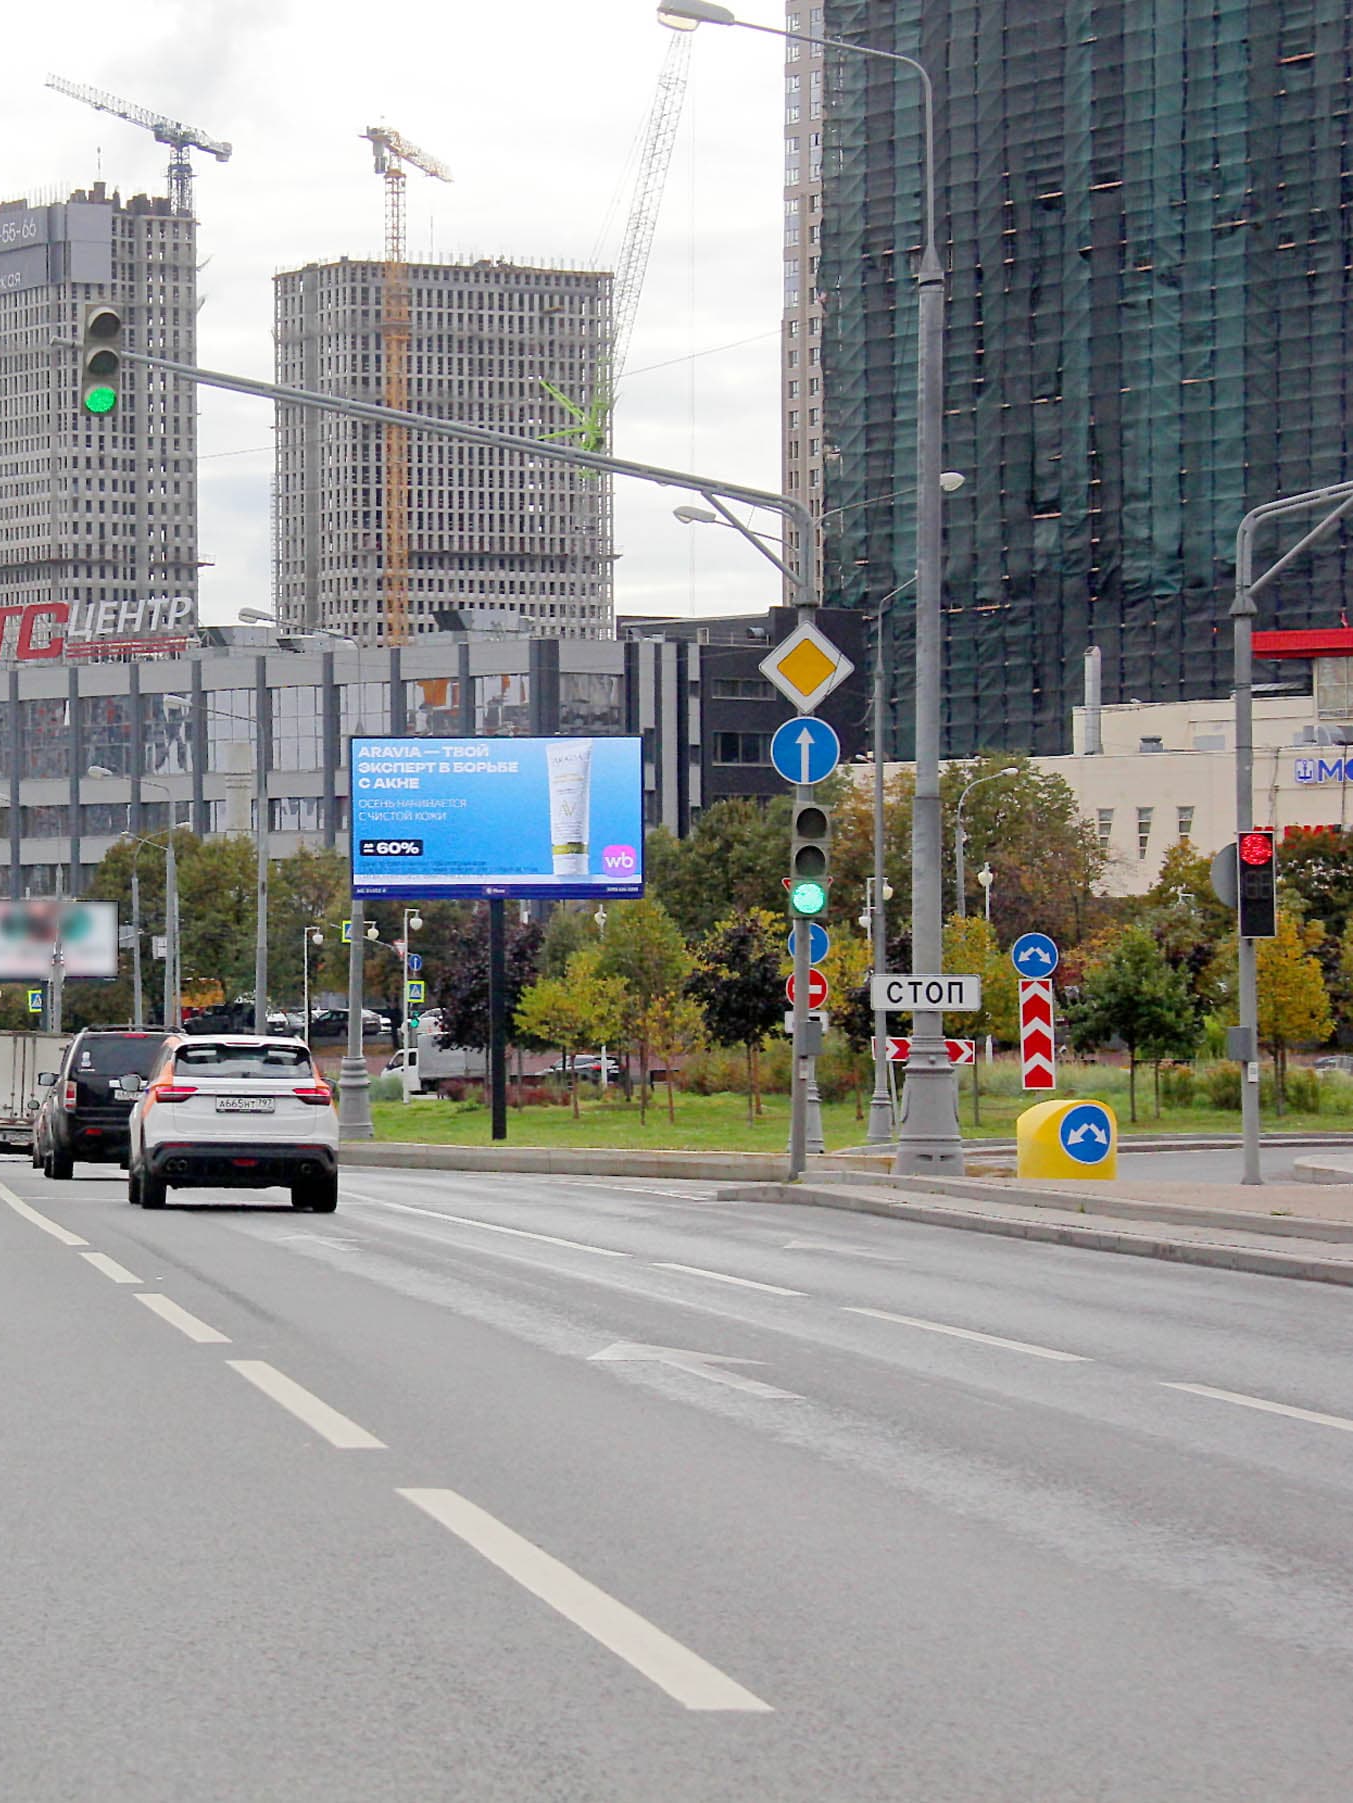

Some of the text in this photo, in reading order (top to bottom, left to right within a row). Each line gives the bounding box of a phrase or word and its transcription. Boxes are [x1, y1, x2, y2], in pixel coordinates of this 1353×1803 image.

[68, 597, 193, 642] ЦЕНТР
[359, 746, 422, 758] ARAVIA
[442, 744, 489, 758] ТВОЙ
[358, 761, 520, 774] ЭКСПЕРТ В БОРЬБЕ
[358, 777, 421, 790] С АКНЕ
[604, 852, 634, 869] wb
[886, 980, 964, 1004] СТОП
